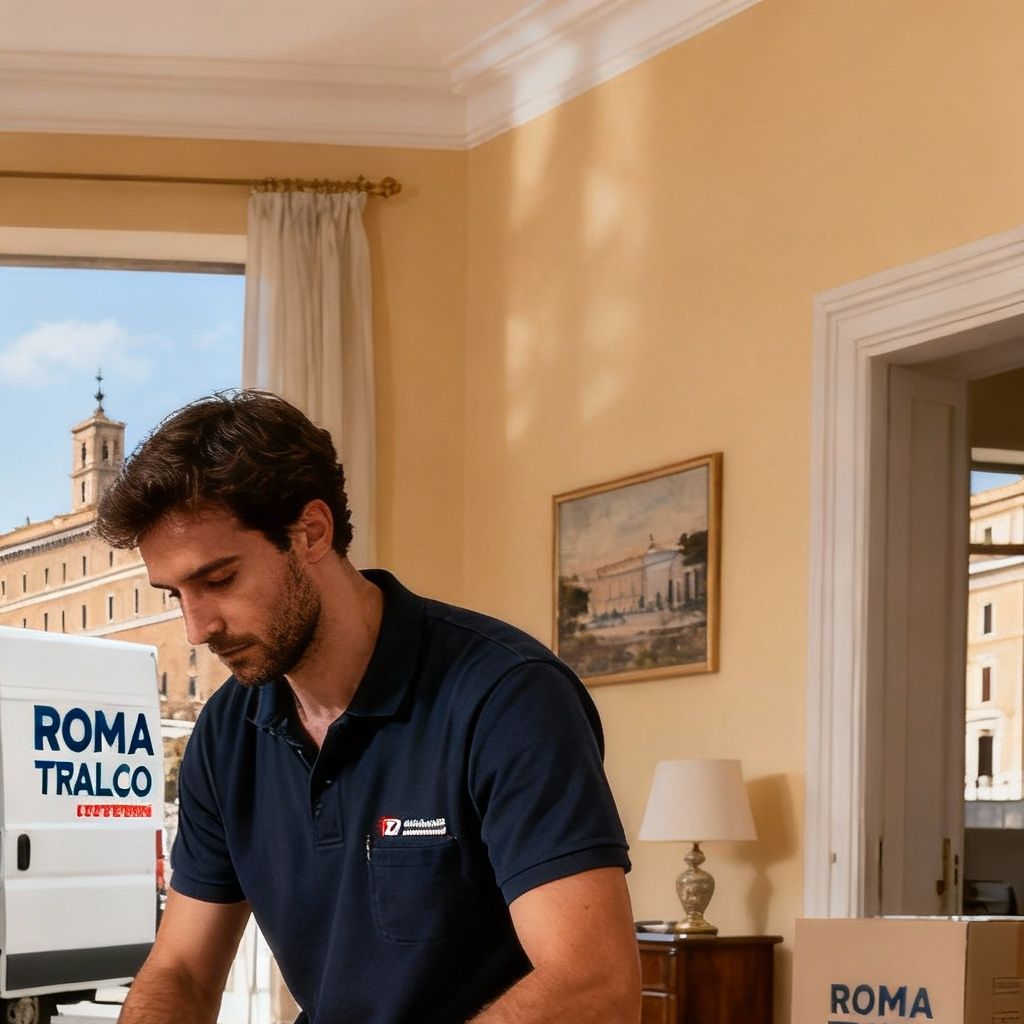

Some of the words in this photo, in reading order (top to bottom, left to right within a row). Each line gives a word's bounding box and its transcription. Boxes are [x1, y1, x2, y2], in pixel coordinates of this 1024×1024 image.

[34, 705, 154, 756] ROMA
[34, 760, 152, 797] TRALCO
[830, 983, 933, 1019] ROMA
